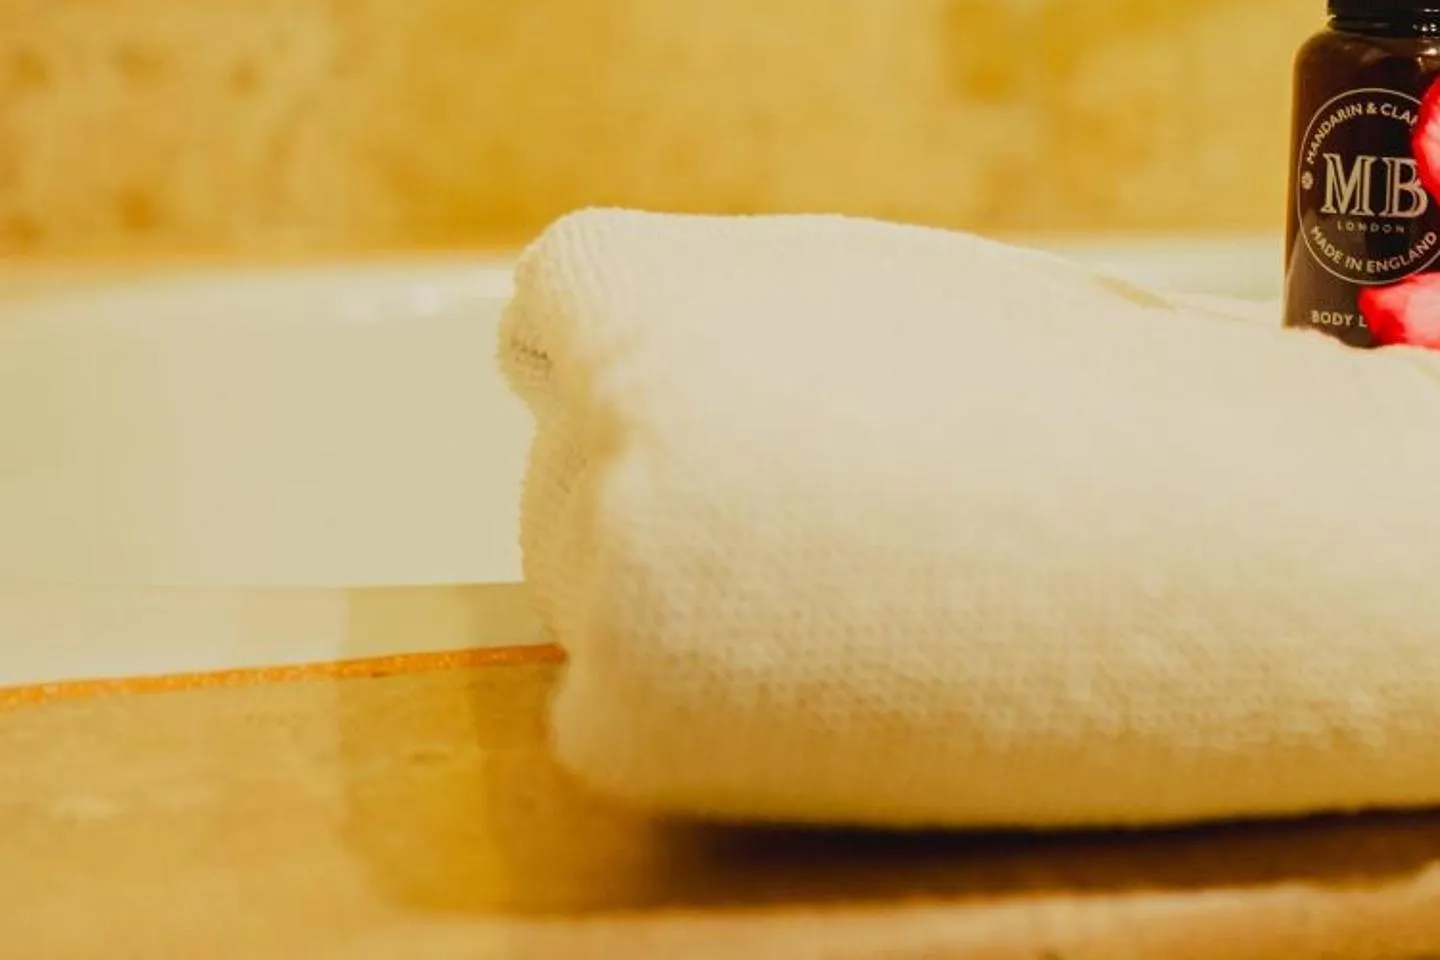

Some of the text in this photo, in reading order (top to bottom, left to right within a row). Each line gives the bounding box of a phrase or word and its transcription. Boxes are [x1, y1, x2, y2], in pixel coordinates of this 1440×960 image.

[1306, 102, 1418, 164] MANDARIN & CLA
[1320, 153, 1429, 218] MB
[1310, 226, 1438, 274] MADE IN ENGLAND
[1337, 220, 1405, 234] LONDON
[1311, 310, 1354, 325] BODY
